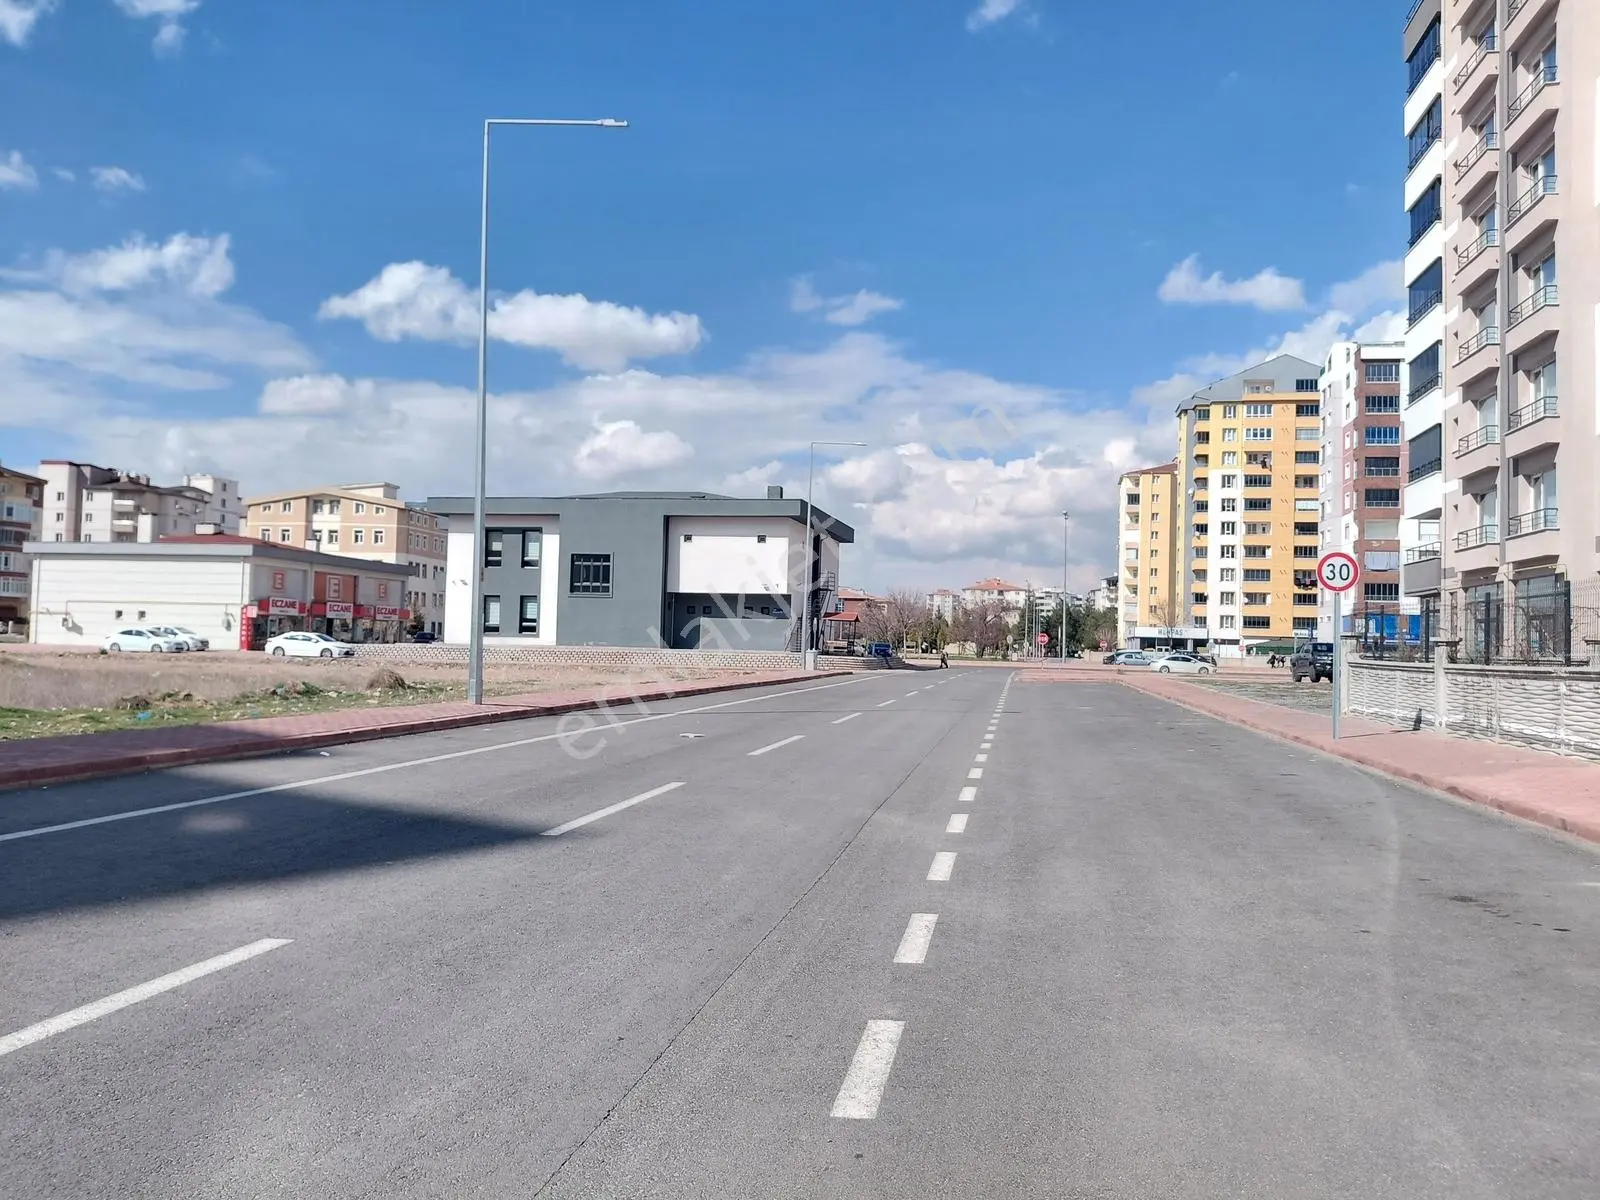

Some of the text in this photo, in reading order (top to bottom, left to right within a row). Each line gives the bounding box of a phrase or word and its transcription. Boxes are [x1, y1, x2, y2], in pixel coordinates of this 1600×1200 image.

[1326, 563, 1350, 581] 30
[271, 599, 298, 610] ECZANE
[328, 603, 353, 613] ECZANE
[376, 607, 399, 616] ECZANE
